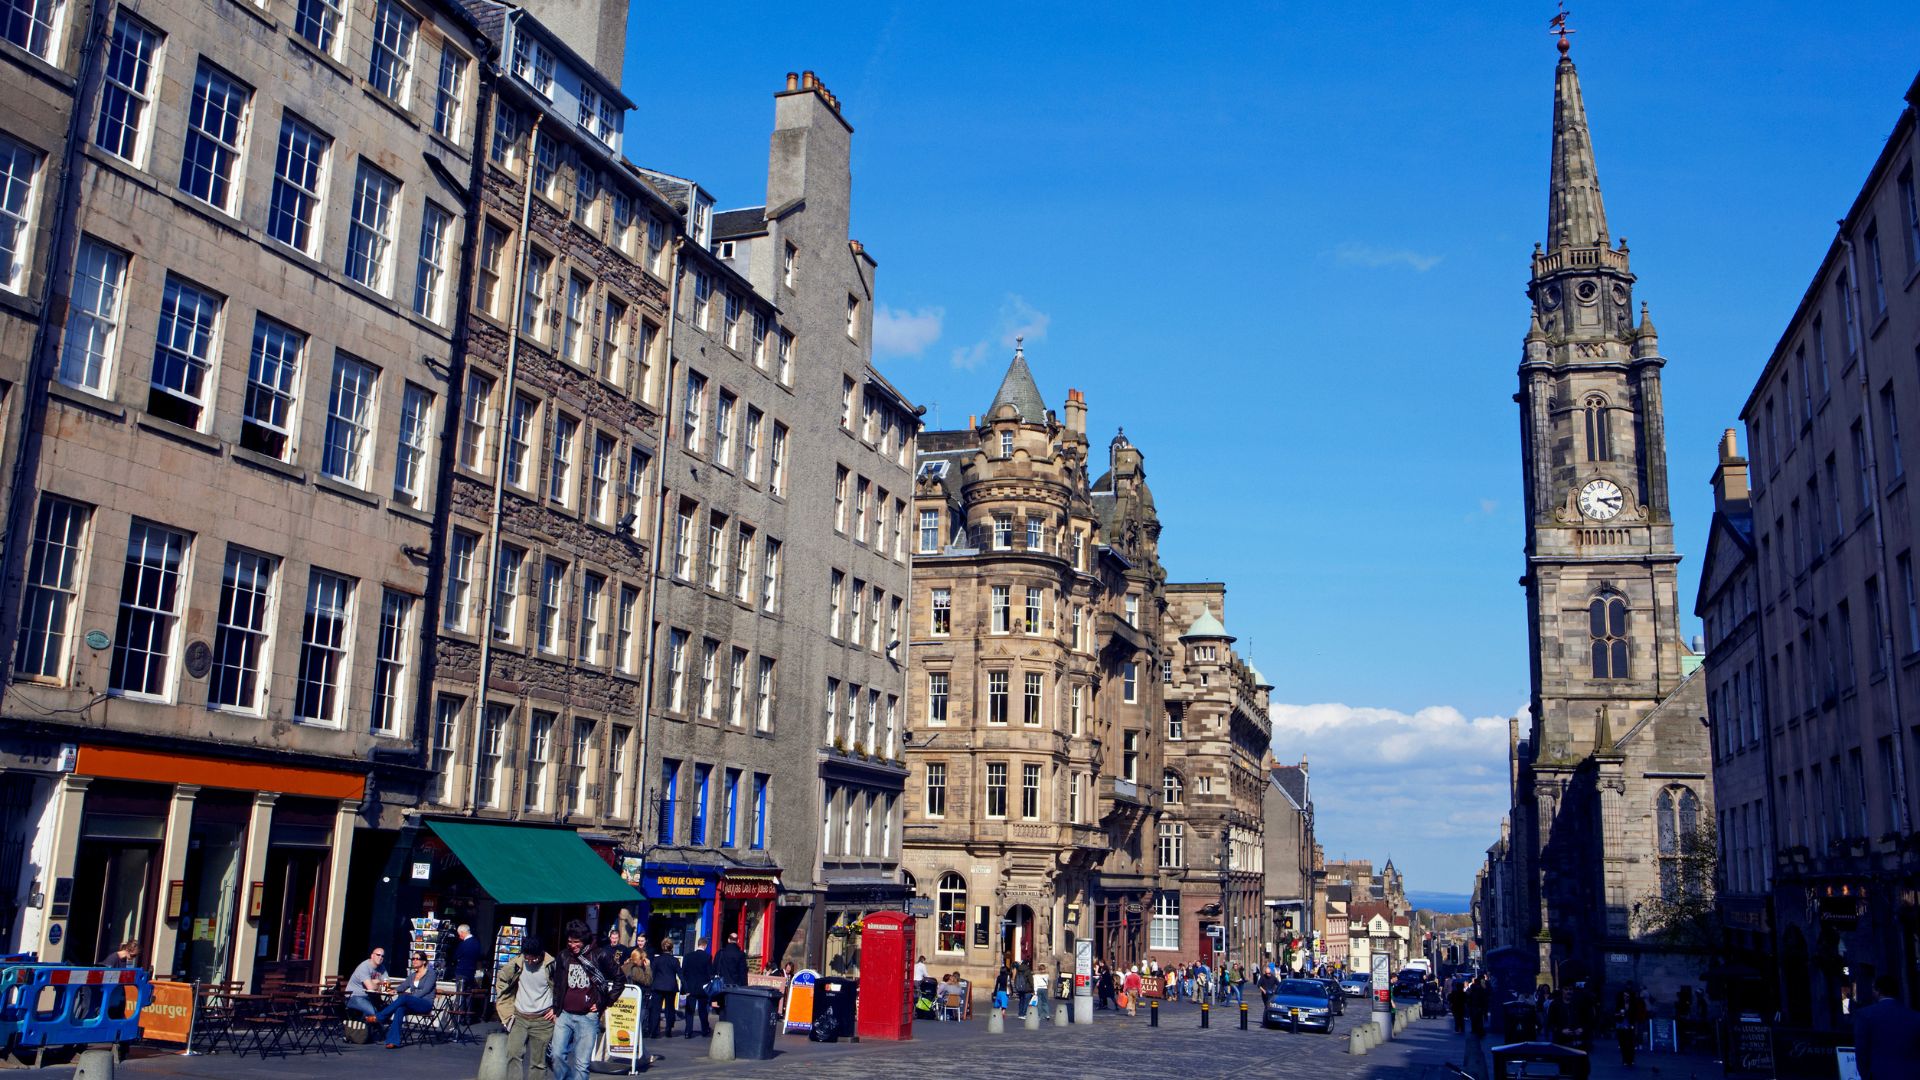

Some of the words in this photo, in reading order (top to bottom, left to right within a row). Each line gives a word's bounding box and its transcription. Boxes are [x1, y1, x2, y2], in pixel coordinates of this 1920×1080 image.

[657, 876, 677, 885] BUREAU
[678, 877, 685, 885] DE
[686, 877, 705, 886] CHANGE
[1141, 978, 1158, 986] ELLA
